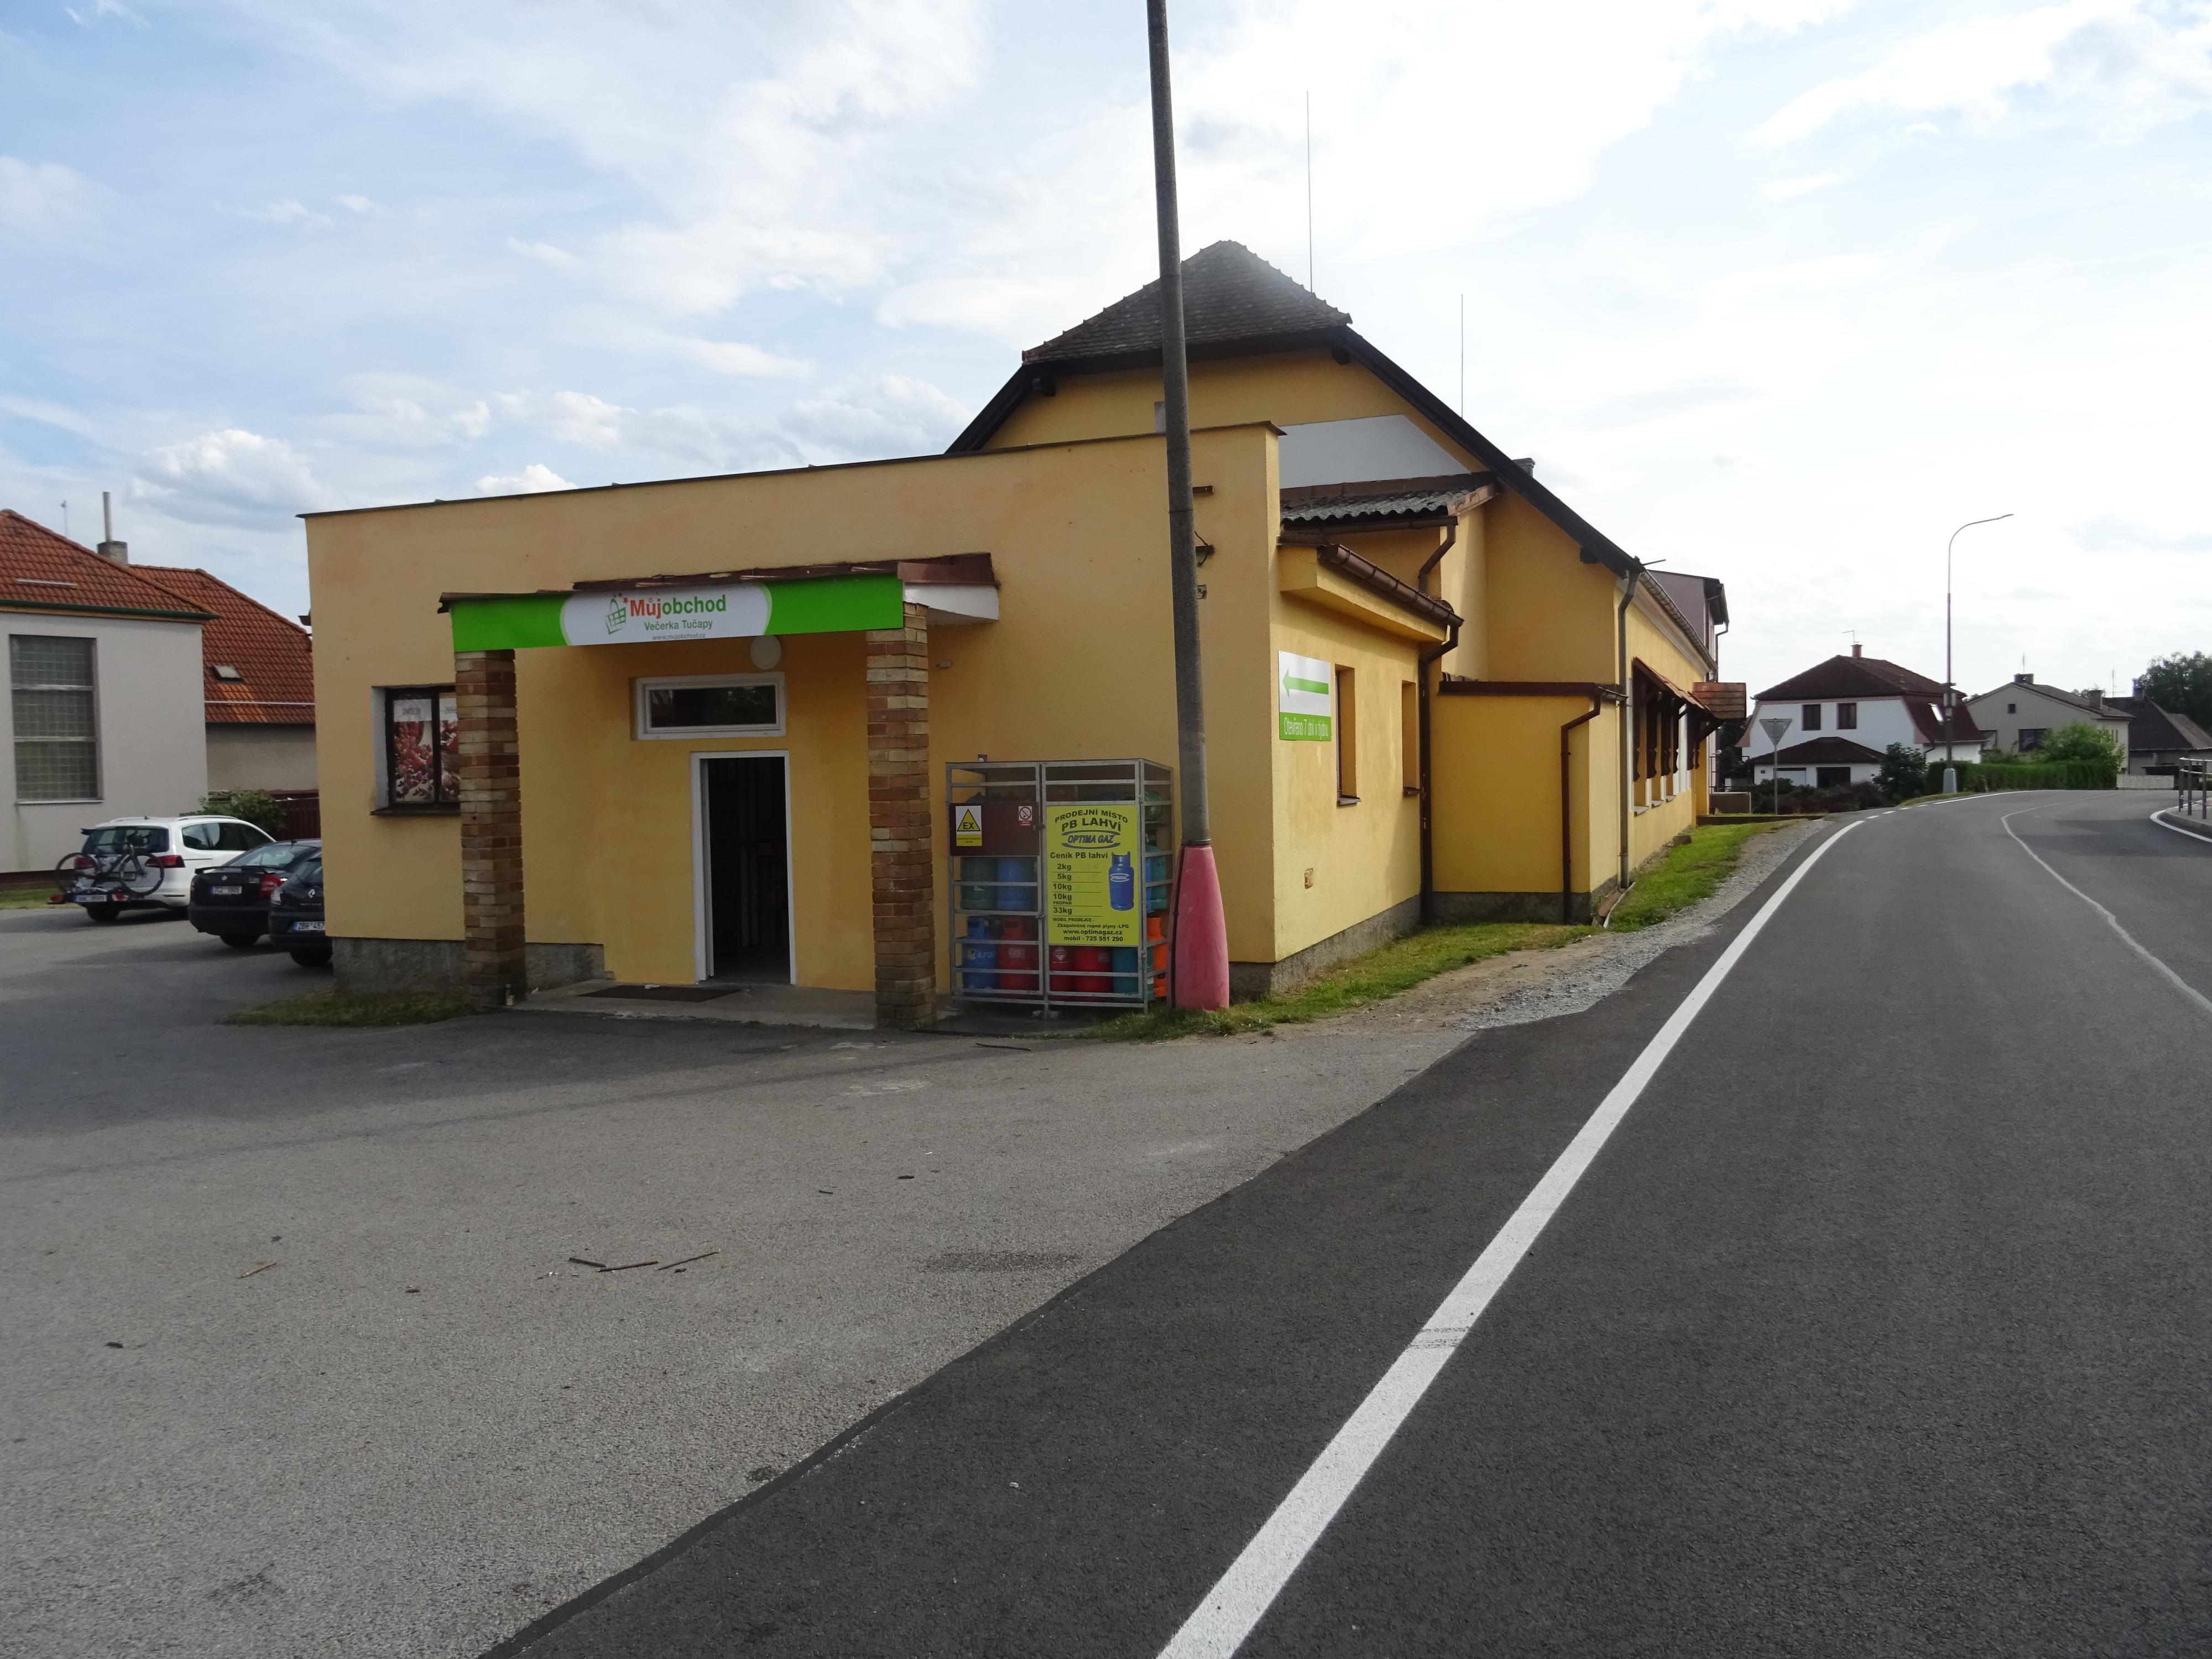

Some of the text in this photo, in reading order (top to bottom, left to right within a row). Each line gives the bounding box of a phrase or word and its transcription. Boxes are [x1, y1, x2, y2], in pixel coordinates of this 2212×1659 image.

[630, 594, 726, 619] Můjobchod
[644, 619, 713, 630] Večerka Tučapy
[1284, 717, 1303, 736] Otevřeno
[1303, 719, 1307, 735] 7
[1314, 723, 1318, 736] v
[1055, 808, 1128, 823] PRODEJNÍ MÍSTO
[1062, 817, 1121, 832] PB LAHVÍ
[1067, 834, 1115, 843] OPTIMA GAZ
